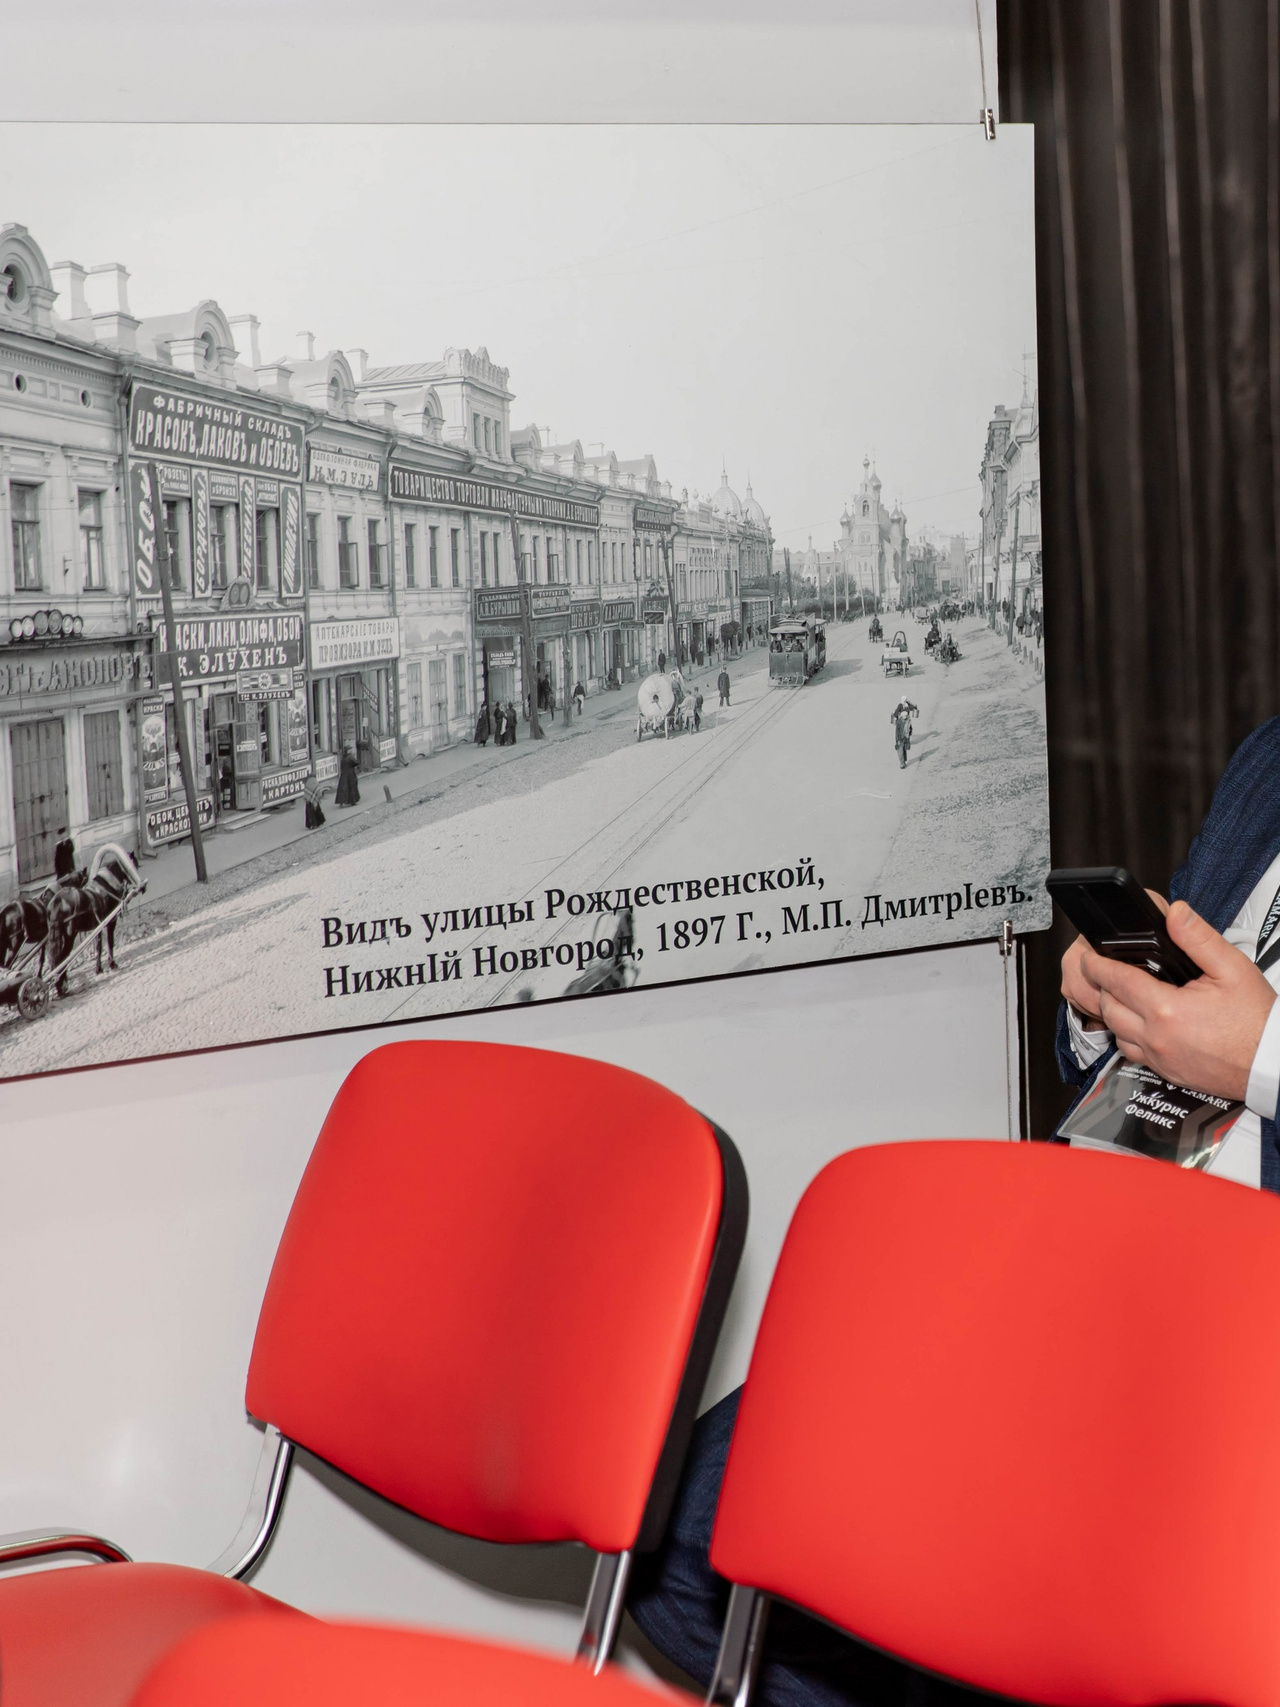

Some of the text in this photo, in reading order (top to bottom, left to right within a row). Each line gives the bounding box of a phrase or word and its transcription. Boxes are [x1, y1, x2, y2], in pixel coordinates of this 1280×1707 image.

[153, 394, 292, 440] ФАБРИЧНЫЙ СКЛАДЪ
[135, 409, 199, 460] КРАСОКЪ,
[200, 423, 247, 463] ЛАКОВЪ
[259, 437, 299, 474] ОБОЕВЪ
[353, 459, 377, 472] ФАБРИКА
[394, 470, 455, 501] ТОВАРИЩЕСТВО
[196, 475, 207, 593] БОРДЮРЫ
[160, 616, 300, 654] КАСКИ, ЛАКИ, ОЛИФА, ОБОИ
[200, 645, 288, 675] ЭЛУХЕНЪ
[268, 781, 305, 799] КАРТОНЪ
[160, 812, 208, 837] КРАСКОТКИ
[175, 800, 209, 819] ЦЕМТЪ
[321, 857, 826, 949] Видъ улицы Рождественской,
[472, 934, 645, 978] Новгород,
[657, 914, 725, 953] 1897
[736, 911, 772, 944] Г.,
[781, 899, 852, 936] М.П.
[1125, 1103, 1176, 1129] Феликс
[1129, 1090, 1190, 1119] Ужкурис
